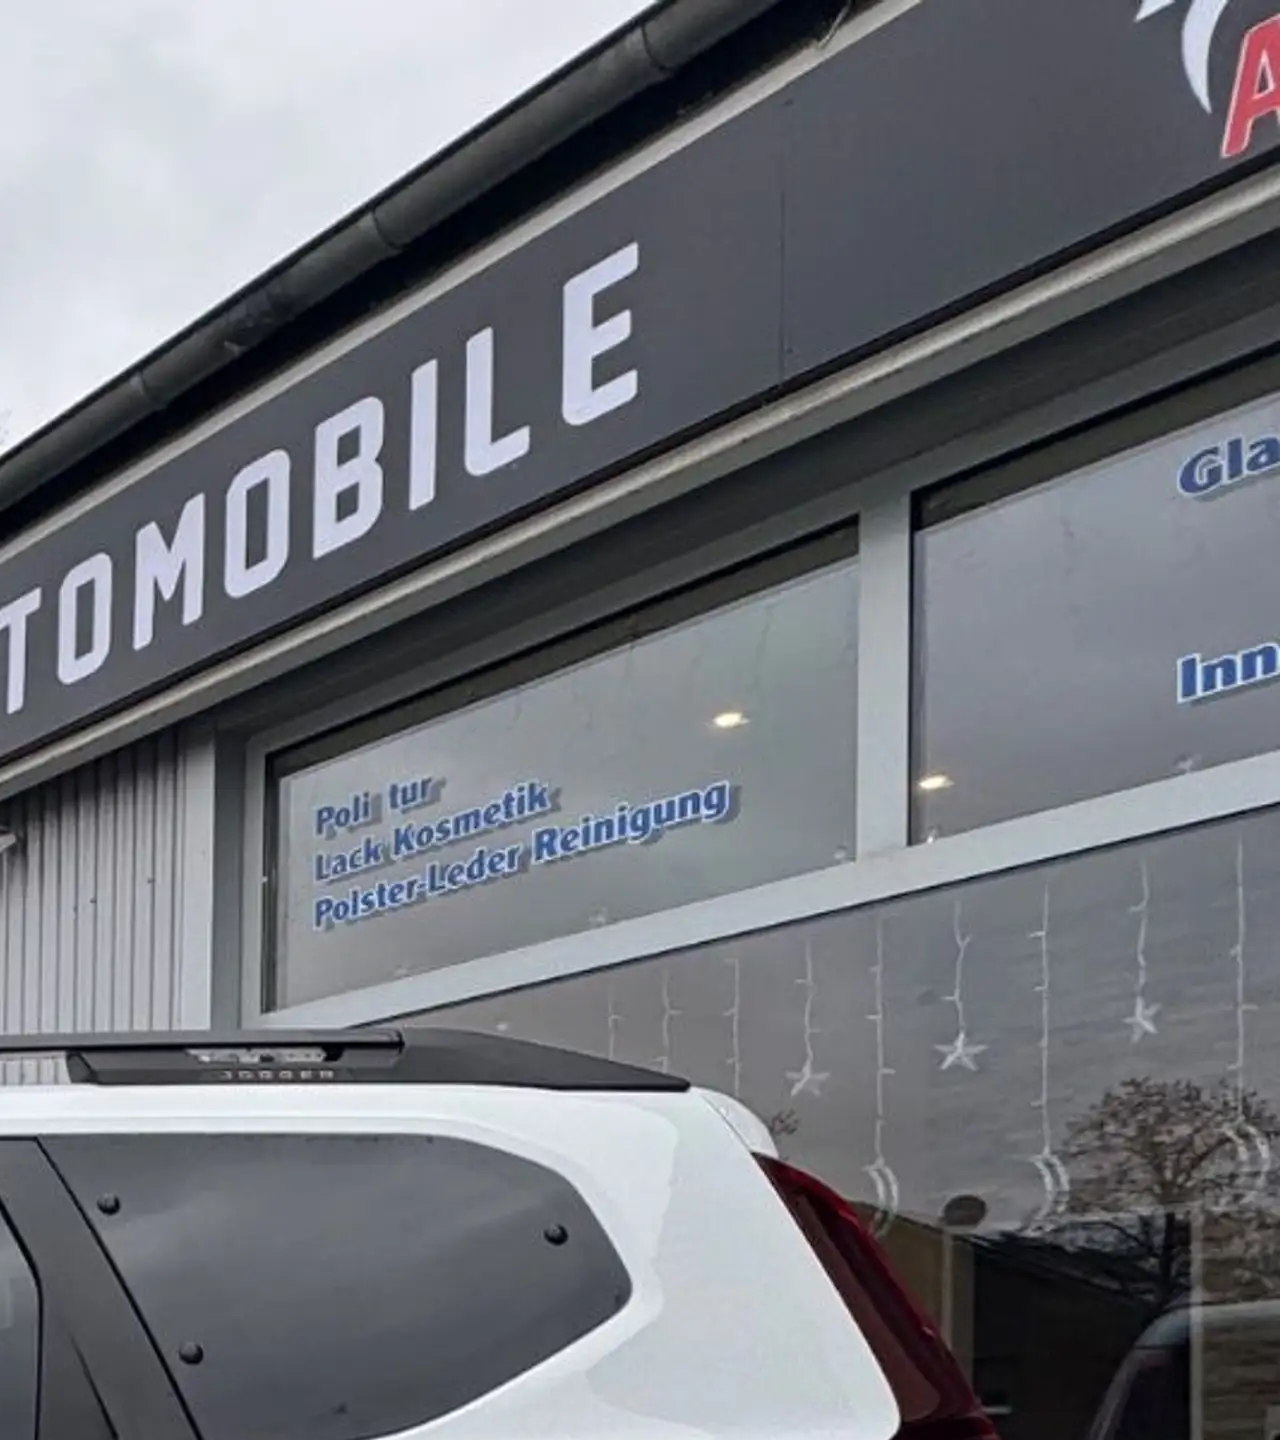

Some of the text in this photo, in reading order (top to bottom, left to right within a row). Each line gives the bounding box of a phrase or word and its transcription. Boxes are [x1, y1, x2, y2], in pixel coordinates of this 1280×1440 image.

[1177, 641, 1280, 704] Inn
[313, 781, 550, 882] Lack Kosmetik
[314, 790, 372, 838] Poli
[313, 780, 730, 931] Polster-Leder Reinigung
